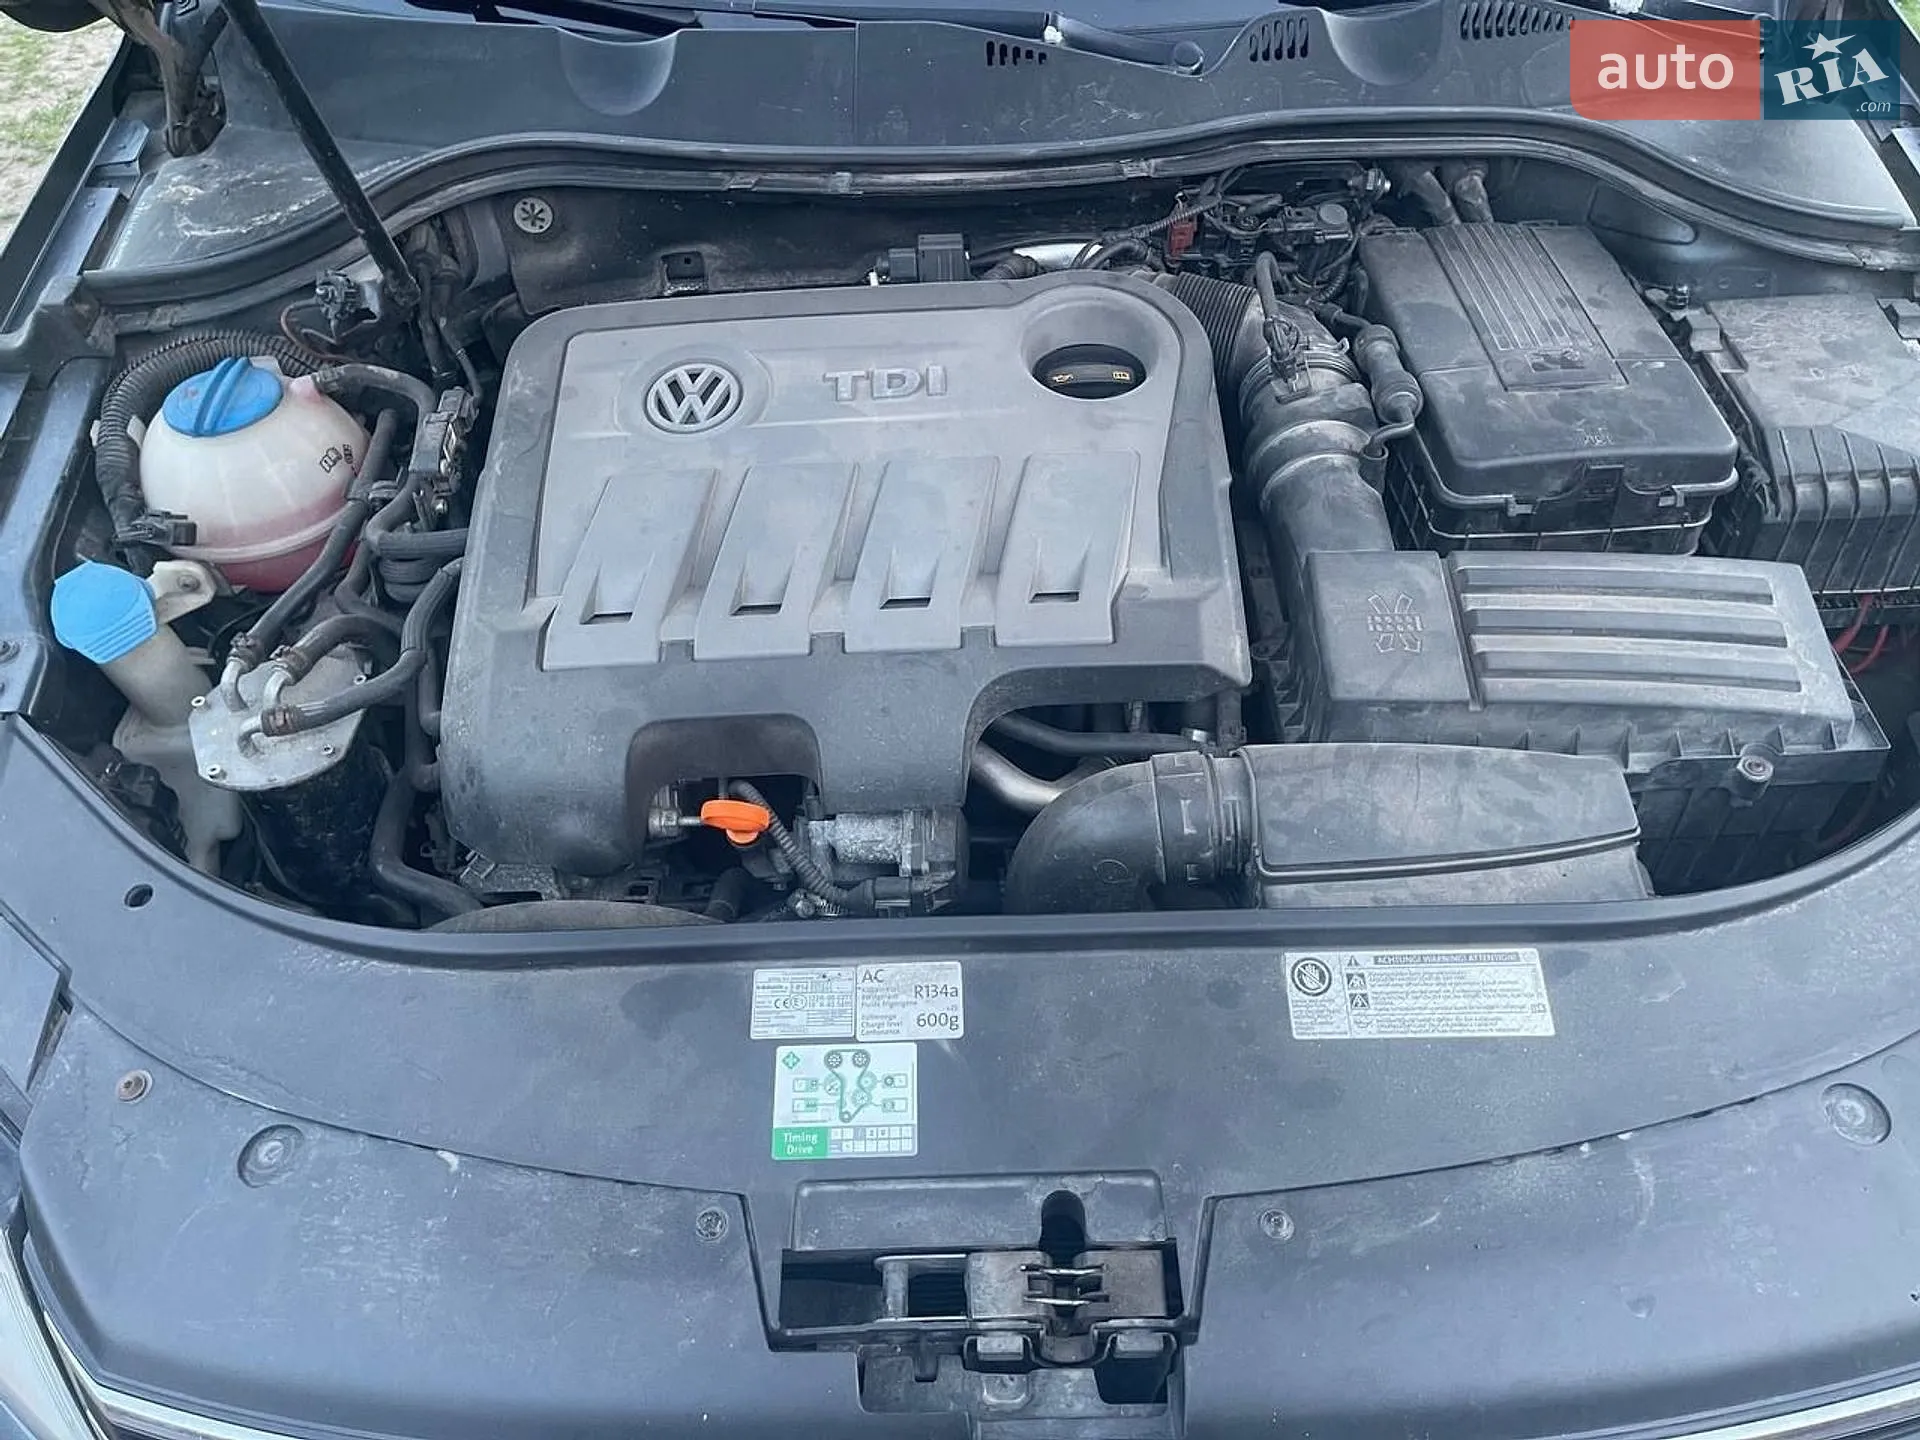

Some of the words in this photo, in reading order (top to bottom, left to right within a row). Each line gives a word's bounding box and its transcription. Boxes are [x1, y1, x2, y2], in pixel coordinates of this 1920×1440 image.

[822, 364, 948, 401] TDI
[862, 968, 885, 984] AC
[914, 984, 959, 999] R134a
[917, 1012, 960, 1031] 600g
[784, 1132, 818, 1145] Timing
[787, 1144, 814, 1155] Drive
